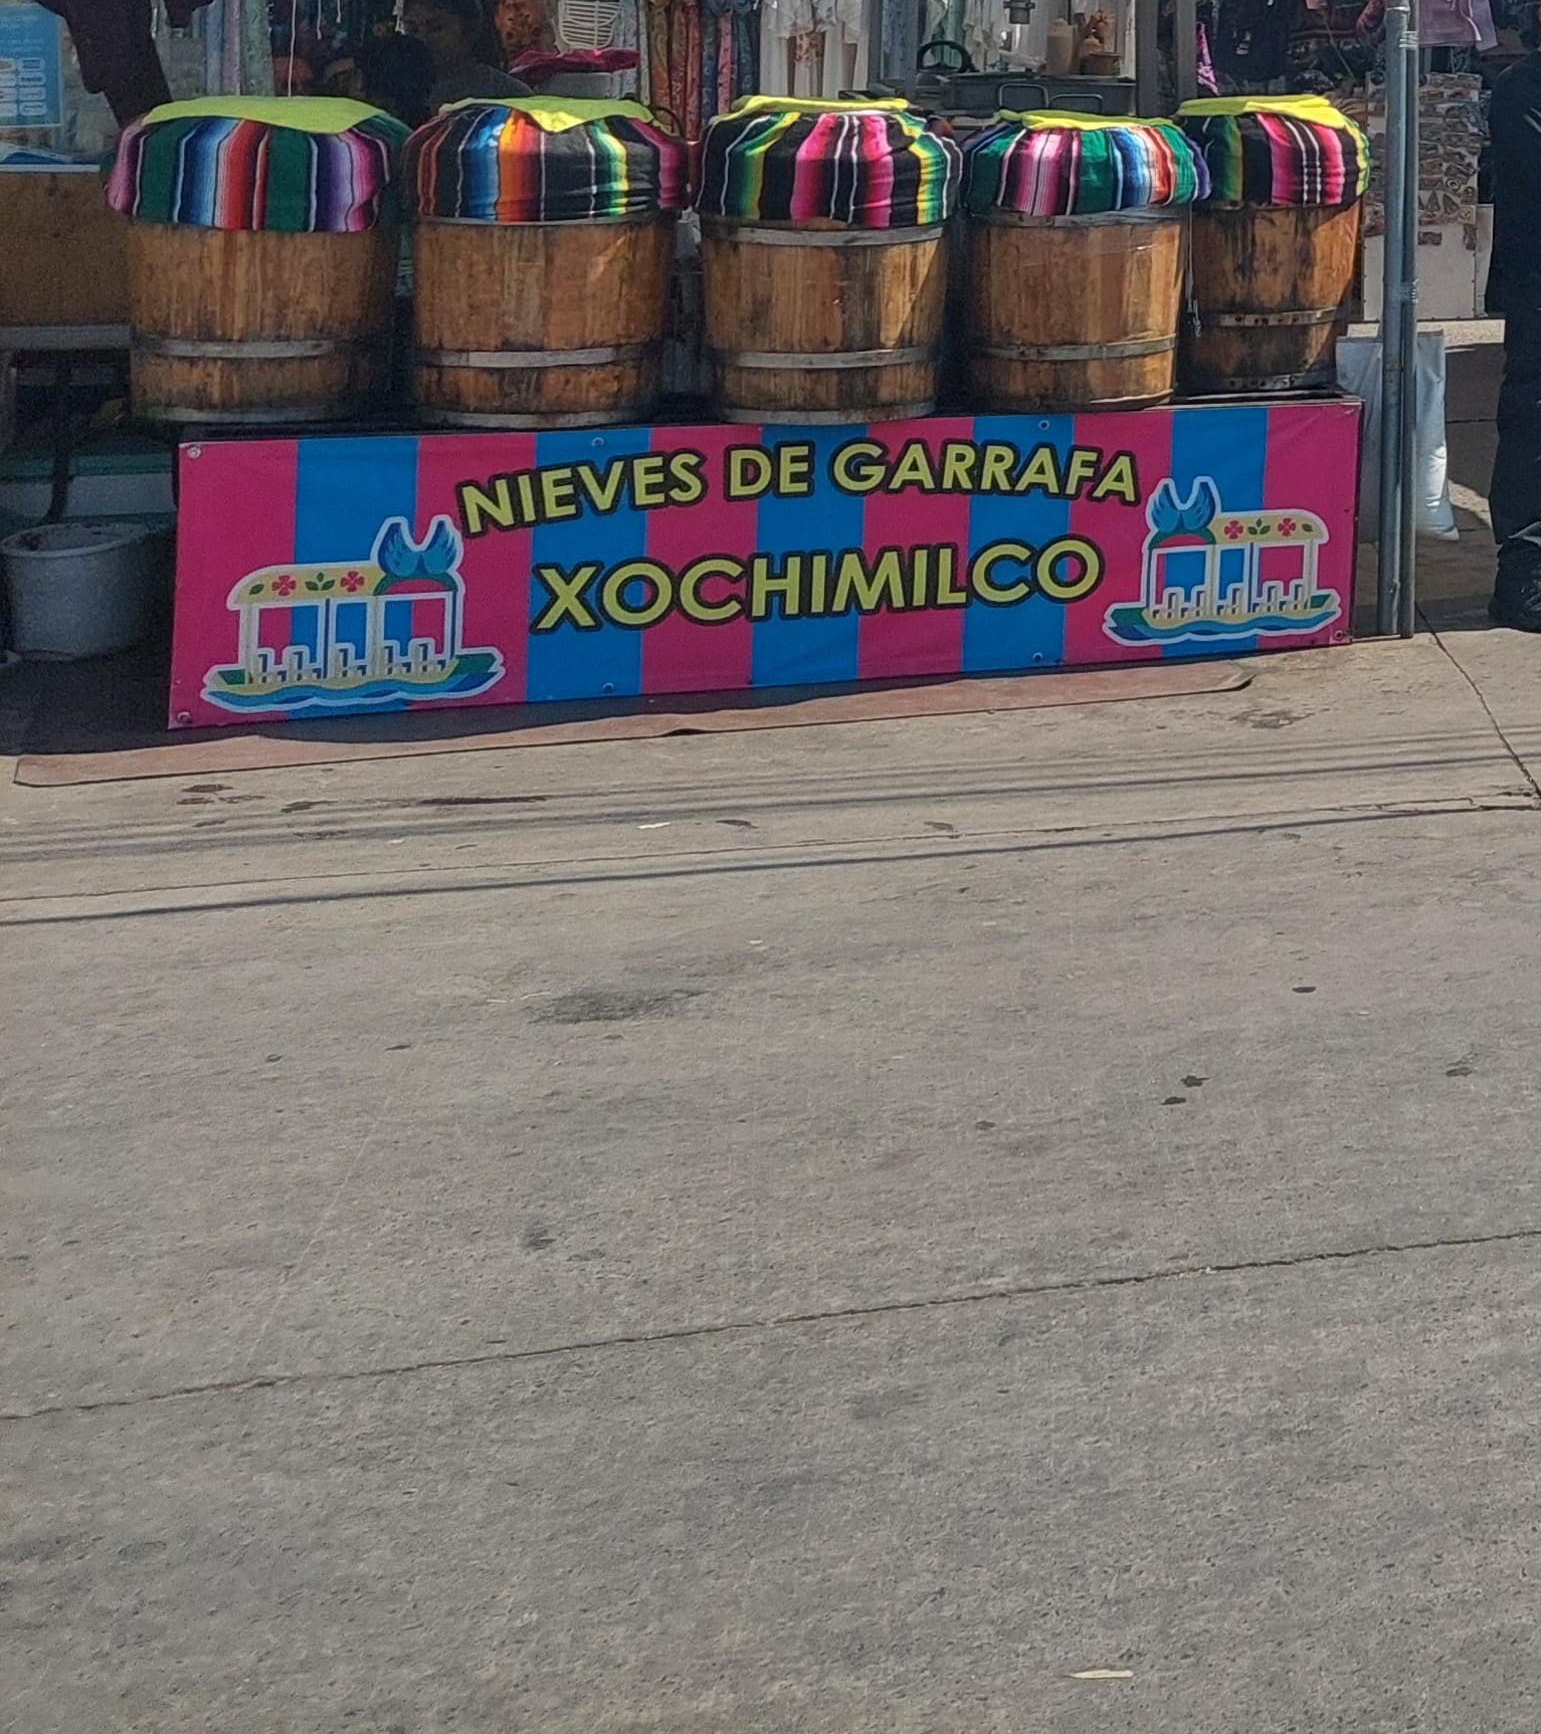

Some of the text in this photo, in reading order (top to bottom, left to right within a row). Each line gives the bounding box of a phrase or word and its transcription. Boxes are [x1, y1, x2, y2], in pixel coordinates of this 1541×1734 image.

[459, 440, 1141, 534] NIEVES DE GARRAFA
[535, 536, 1104, 631] XOCHIMILCO
